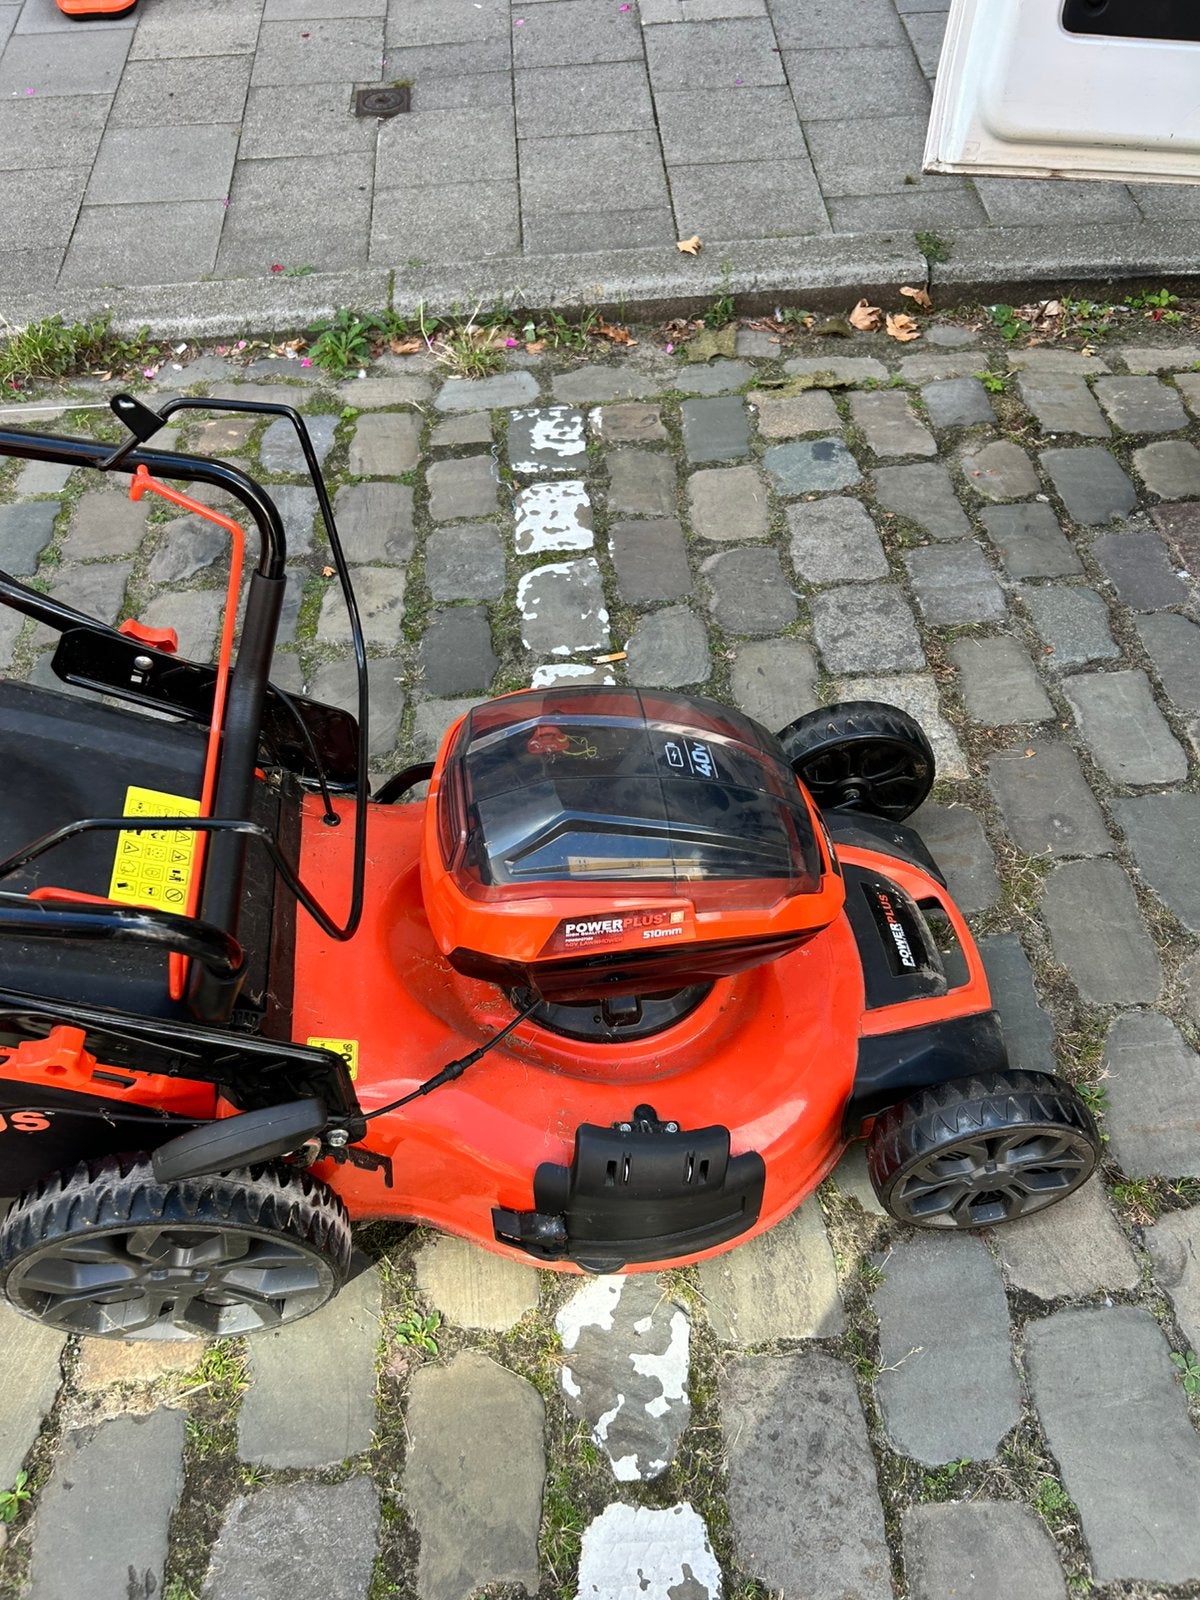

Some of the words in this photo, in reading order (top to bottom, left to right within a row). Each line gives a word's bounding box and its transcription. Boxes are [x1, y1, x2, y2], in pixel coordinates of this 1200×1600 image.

[565, 914, 664, 935] POWERPLUS
[642, 927, 683, 940] 510mm
[878, 894, 913, 968] POWERPLUS
[0, 1111, 51, 1133] S
